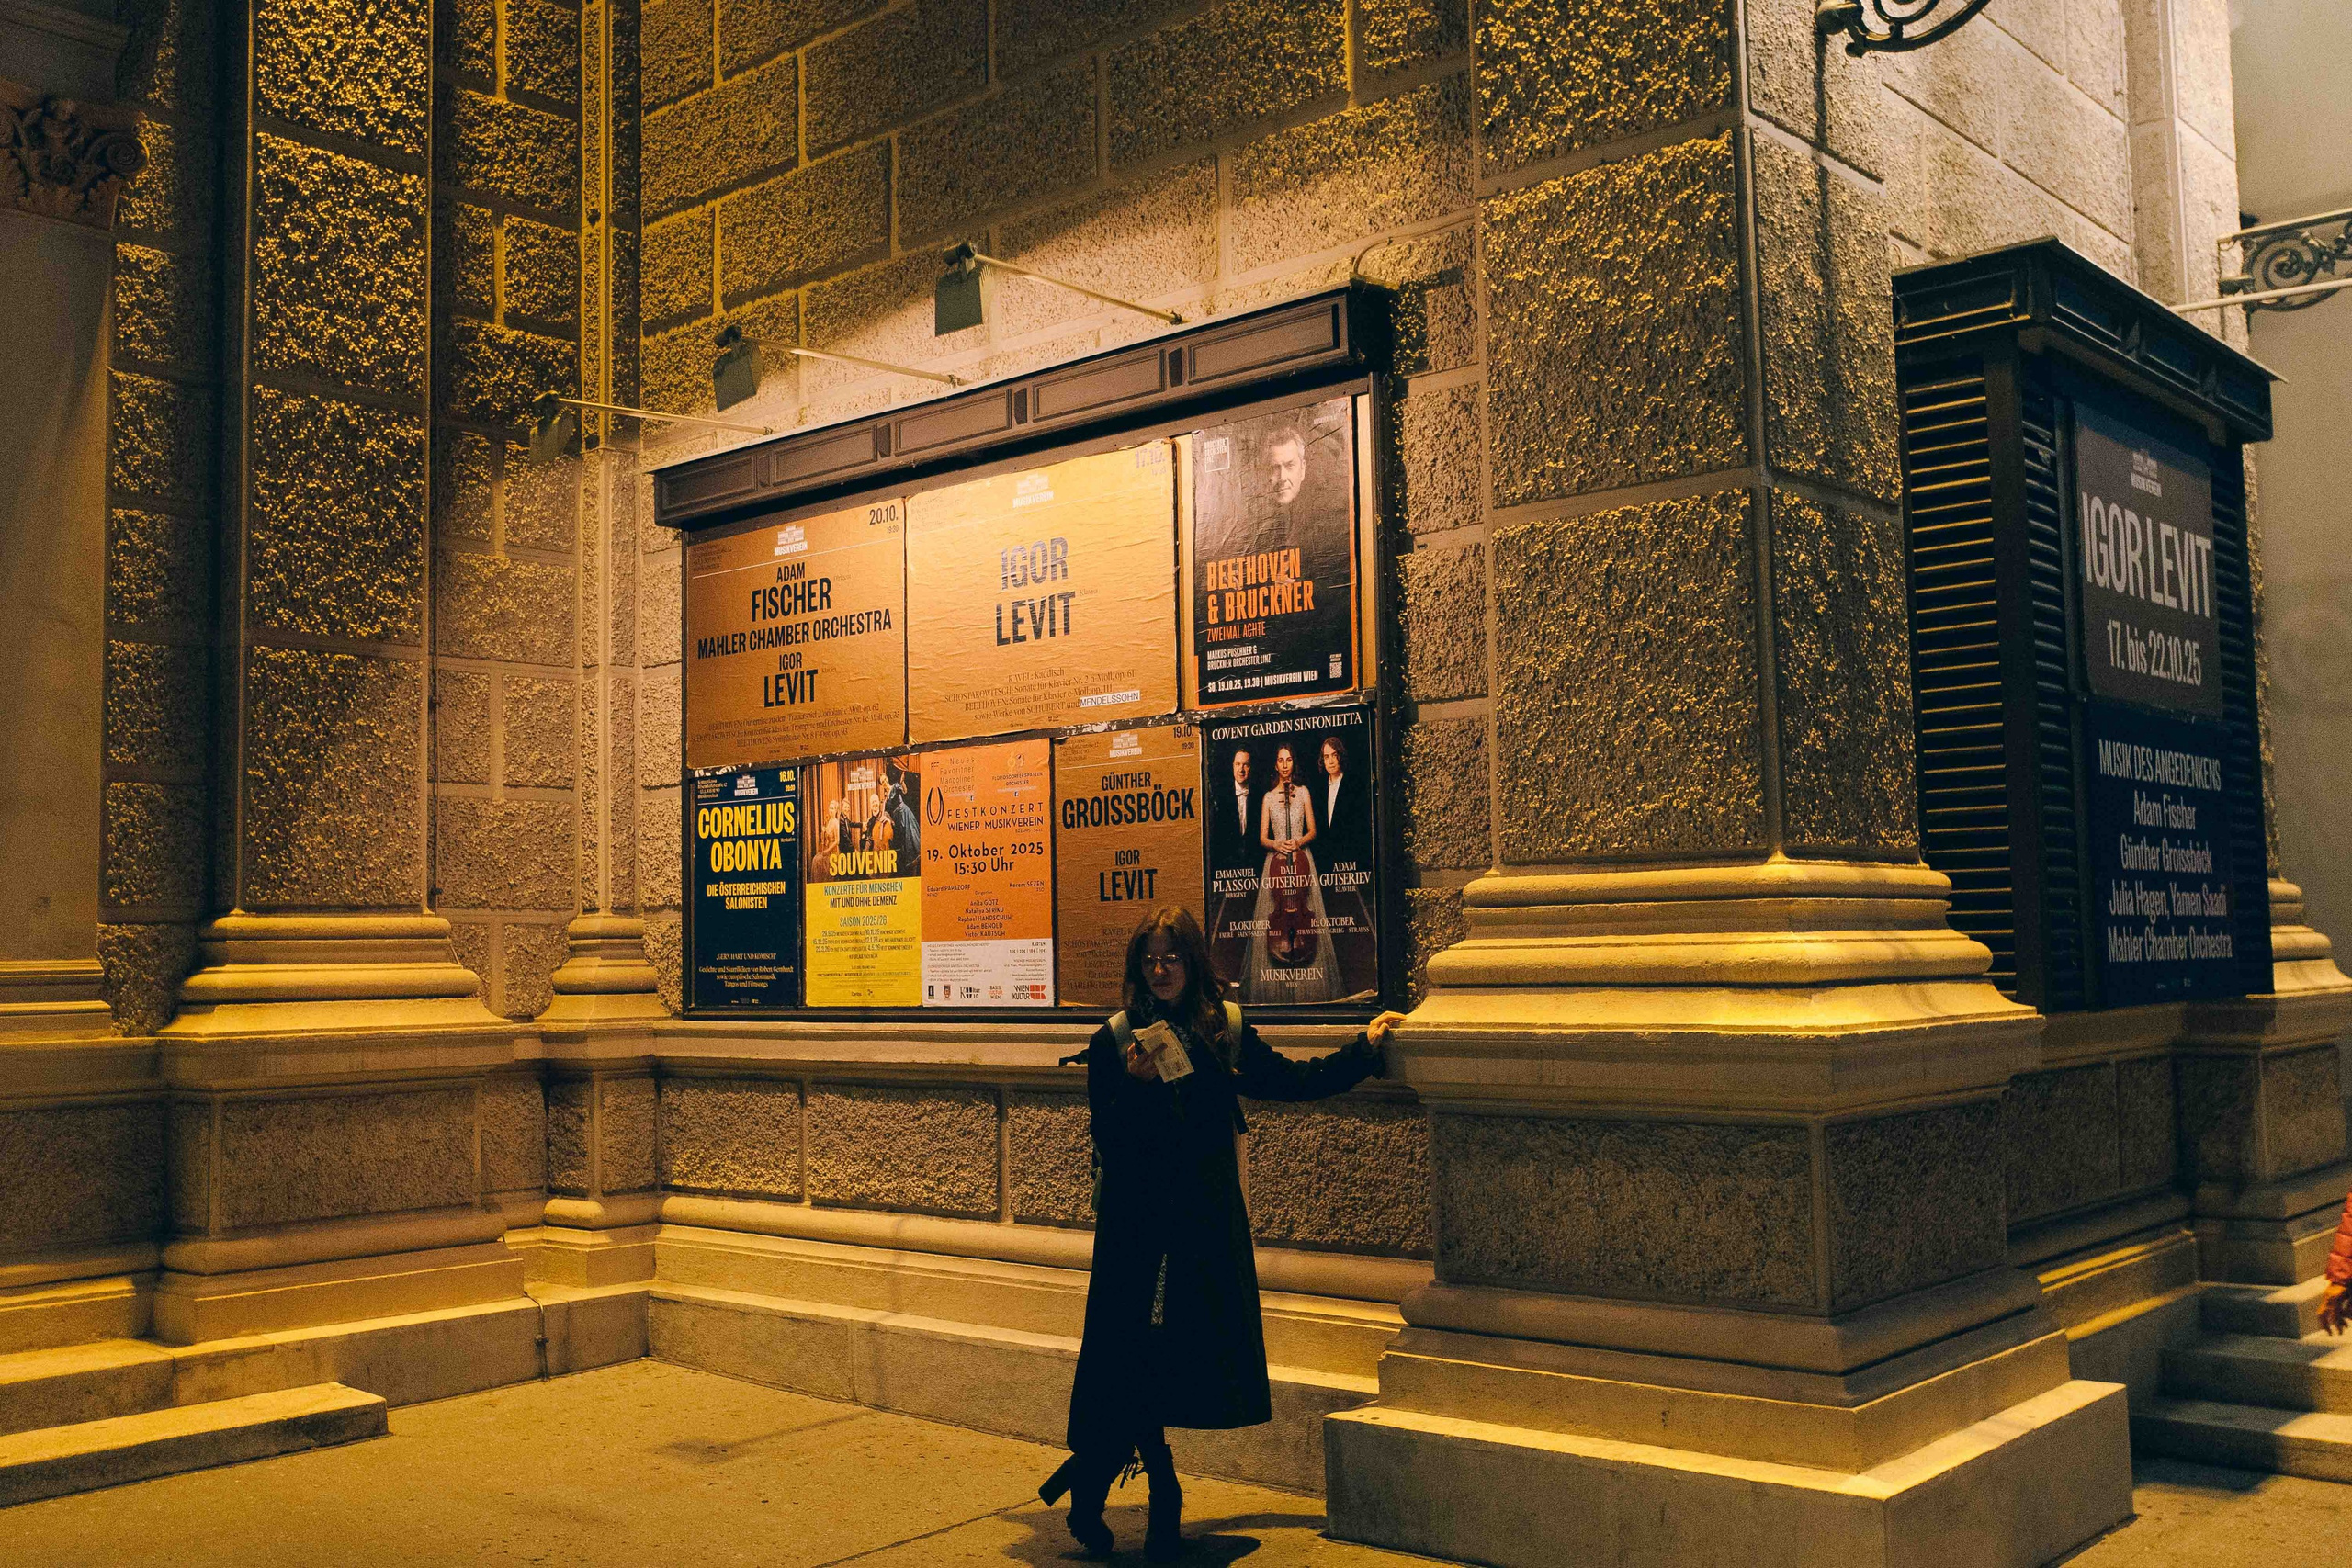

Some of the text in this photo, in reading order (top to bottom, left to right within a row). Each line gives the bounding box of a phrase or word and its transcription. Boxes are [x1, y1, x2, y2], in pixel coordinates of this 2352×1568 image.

[1012, 491, 1054, 508] MUSIKVEREIN
[869, 505, 899, 525] 20.10.
[775, 541, 808, 556] MUSIKVEREIN
[2082, 491, 2211, 619] IGOR LEVIT
[1001, 536, 1069, 591] IGOR
[1207, 548, 1301, 591] BEETHOVEN
[776, 562, 806, 583] ADAM
[752, 577, 831, 622] FISCHER
[1207, 581, 1315, 625] & BRUCKNER
[995, 591, 1075, 647] LEVIT
[697, 608, 892, 660] MAHLER CHAMBER ORCHESTRA
[1207, 621, 1266, 643] ZWEIMAL ACHTE
[779, 652, 802, 671] IGOR
[1207, 649, 1227, 660] MARKUS
[1227, 646, 1252, 658] POSCHNER
[2107, 619, 2201, 687] 17. bis 22.10.25
[1207, 653, 1272, 671] BRUCKNER ORCHESTER LINZ
[1035, 667, 1065, 680] Kaddisch
[1207, 670, 1318, 693] SO, 19.10.25, 19.30 MUSIKVEREIN WIEN
[763, 669, 818, 708] LEVIT
[1037, 680, 1046, 691] für
[1048, 678, 1072, 690] Klavier
[1009, 694, 1031, 705] Sonate
[1033, 692, 1042, 703] für
[1044, 689, 1066, 701] Klavier
[974, 711, 991, 721] sowie
[992, 707, 1012, 718] Werke
[1014, 706, 1026, 716] von
[1026, 701, 1066, 715] SCHUBERT
[1080, 692, 1139, 707] MENDELSSOHN
[1173, 725, 1193, 739] 19.10.
[1212, 711, 1363, 741] COVENT GARDEN SINFONIETTA
[1109, 747, 1142, 758] MUSIKVEREIN
[949, 757, 975, 766] Neues
[2098, 739, 2221, 792] MUSIK DES ANGEDENKENS
[780, 770, 796, 783] 16.10.
[940, 775, 975, 784] Mandolinen
[1102, 772, 1151, 791] GÜNTHER
[847, 781, 876, 791] MUSIKVEREIN
[944, 784, 975, 794] Orchester
[947, 802, 1044, 820] FESTKONZERT
[1062, 784, 1194, 829] GROISSBÖCK
[2134, 789, 2196, 830] Adam Fischer
[698, 801, 796, 840] CORNELIUS
[947, 816, 1044, 833] WIENER MUSIKVEREIN
[710, 838, 782, 873] OBONYA
[927, 842, 1044, 861] 19. Oktober 2025
[1114, 849, 1140, 866] IGOR
[2120, 833, 2213, 874] Günther Groissböck
[829, 849, 897, 876] SOUVENIR
[954, 858, 1014, 875] 15:30 Uhr
[1280, 865, 1297, 875] DALI
[1332, 862, 1357, 873] ADAM
[1216, 868, 1256, 879] EMMANUEL
[1261, 874, 1317, 890] GUTSERIEVA
[1319, 872, 1372, 886] GUTSERIEV
[707, 881, 786, 897] DIE ÖSTERREICHISCHEN
[824, 881, 902, 896] KONZERTE FÜR MENSCHEN
[1100, 869, 1158, 902] LEVIT
[1213, 879, 1259, 893] PLASSON
[725, 897, 768, 910] SALONISTEN
[830, 894, 897, 908] MIT UND OHNE DEMENZ
[2109, 878, 2228, 925] Julia Hagen, Yamen Saadi
[840, 914, 888, 928] SAISON 2025/26
[957, 914, 1012, 924] Raphael HANDSCHUH
[980, 930, 1006, 938] KAUTSCH
[2108, 924, 2233, 963] Mahler Chamber Orchestra
[1260, 967, 1324, 982] MUSIKVEREIN
[1013, 985, 1030, 993] WIEN
